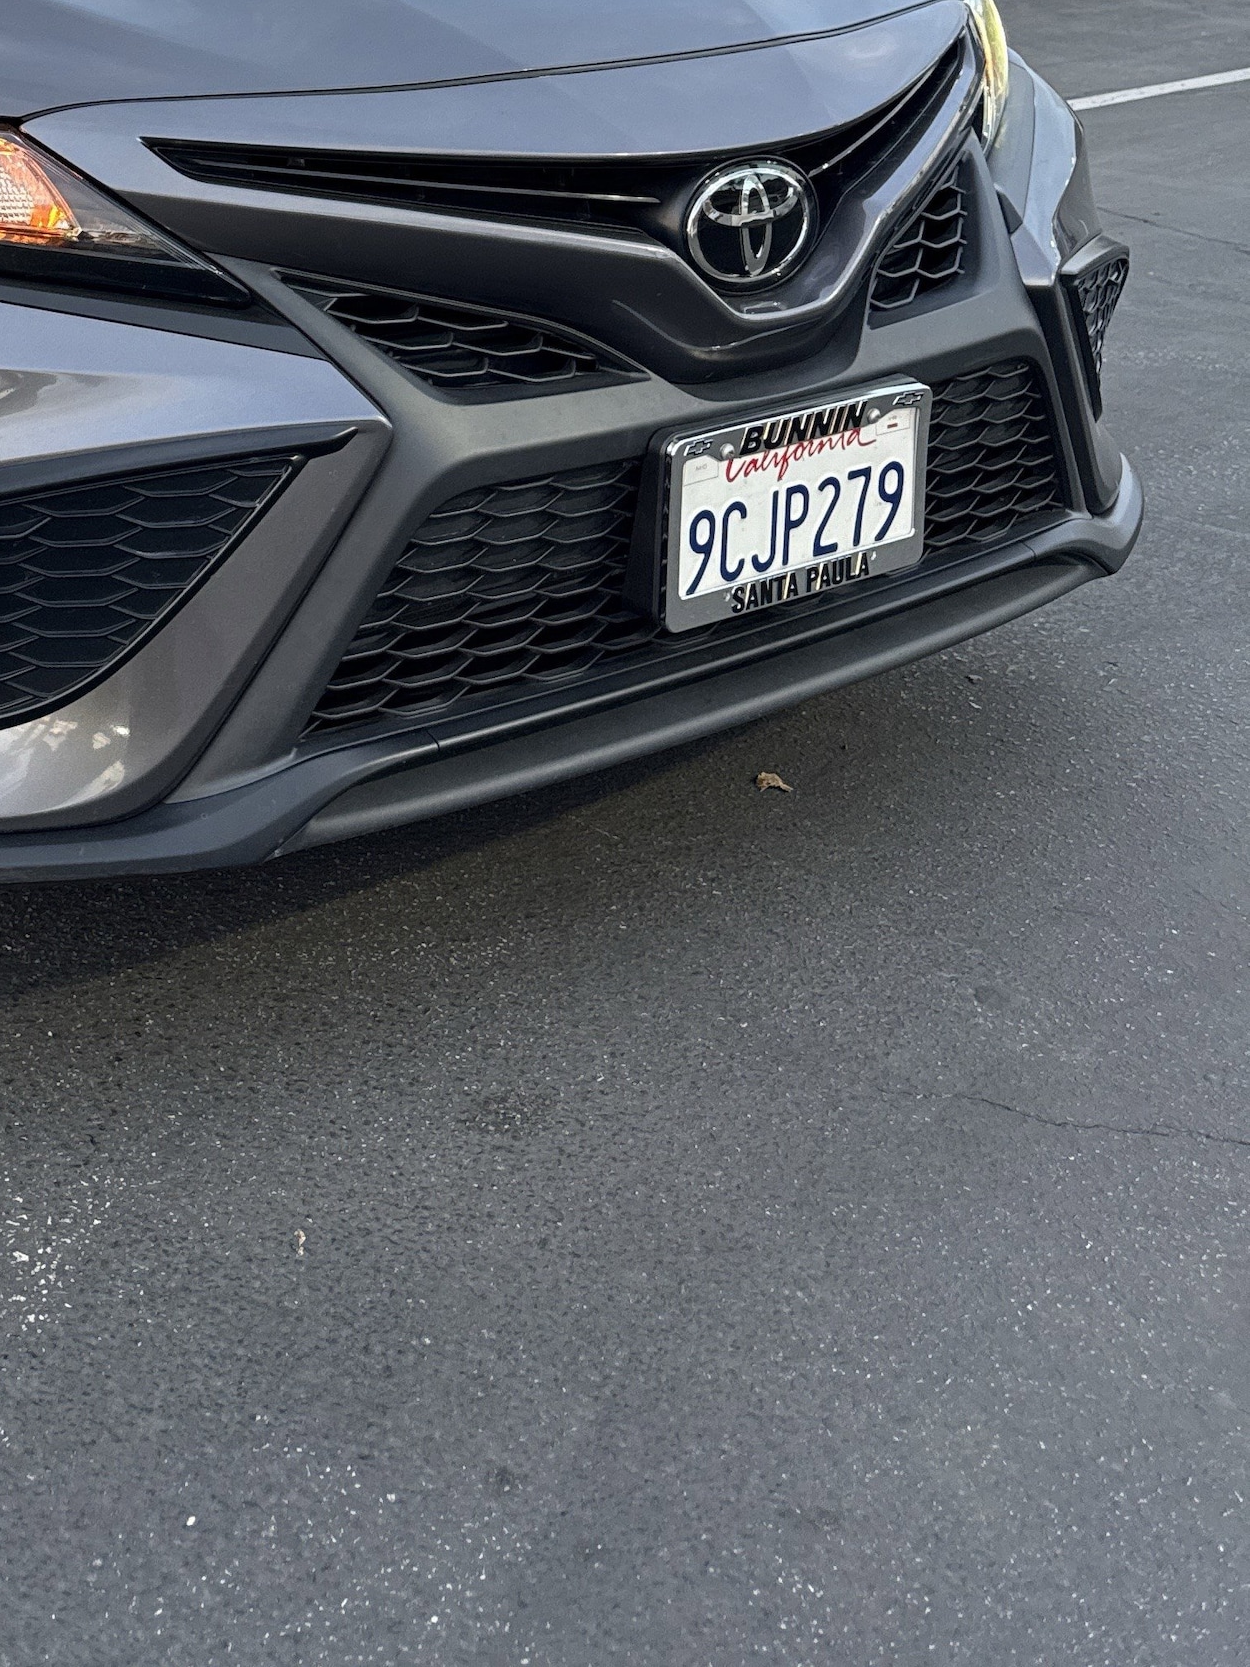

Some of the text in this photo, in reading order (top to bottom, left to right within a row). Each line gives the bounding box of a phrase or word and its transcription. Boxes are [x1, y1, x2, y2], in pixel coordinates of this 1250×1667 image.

[725, 426, 877, 483] California
[739, 400, 868, 456] BUNNIN
[685, 460, 905, 596] 9CJP279
[731, 551, 870, 614] SANTA PAULA
